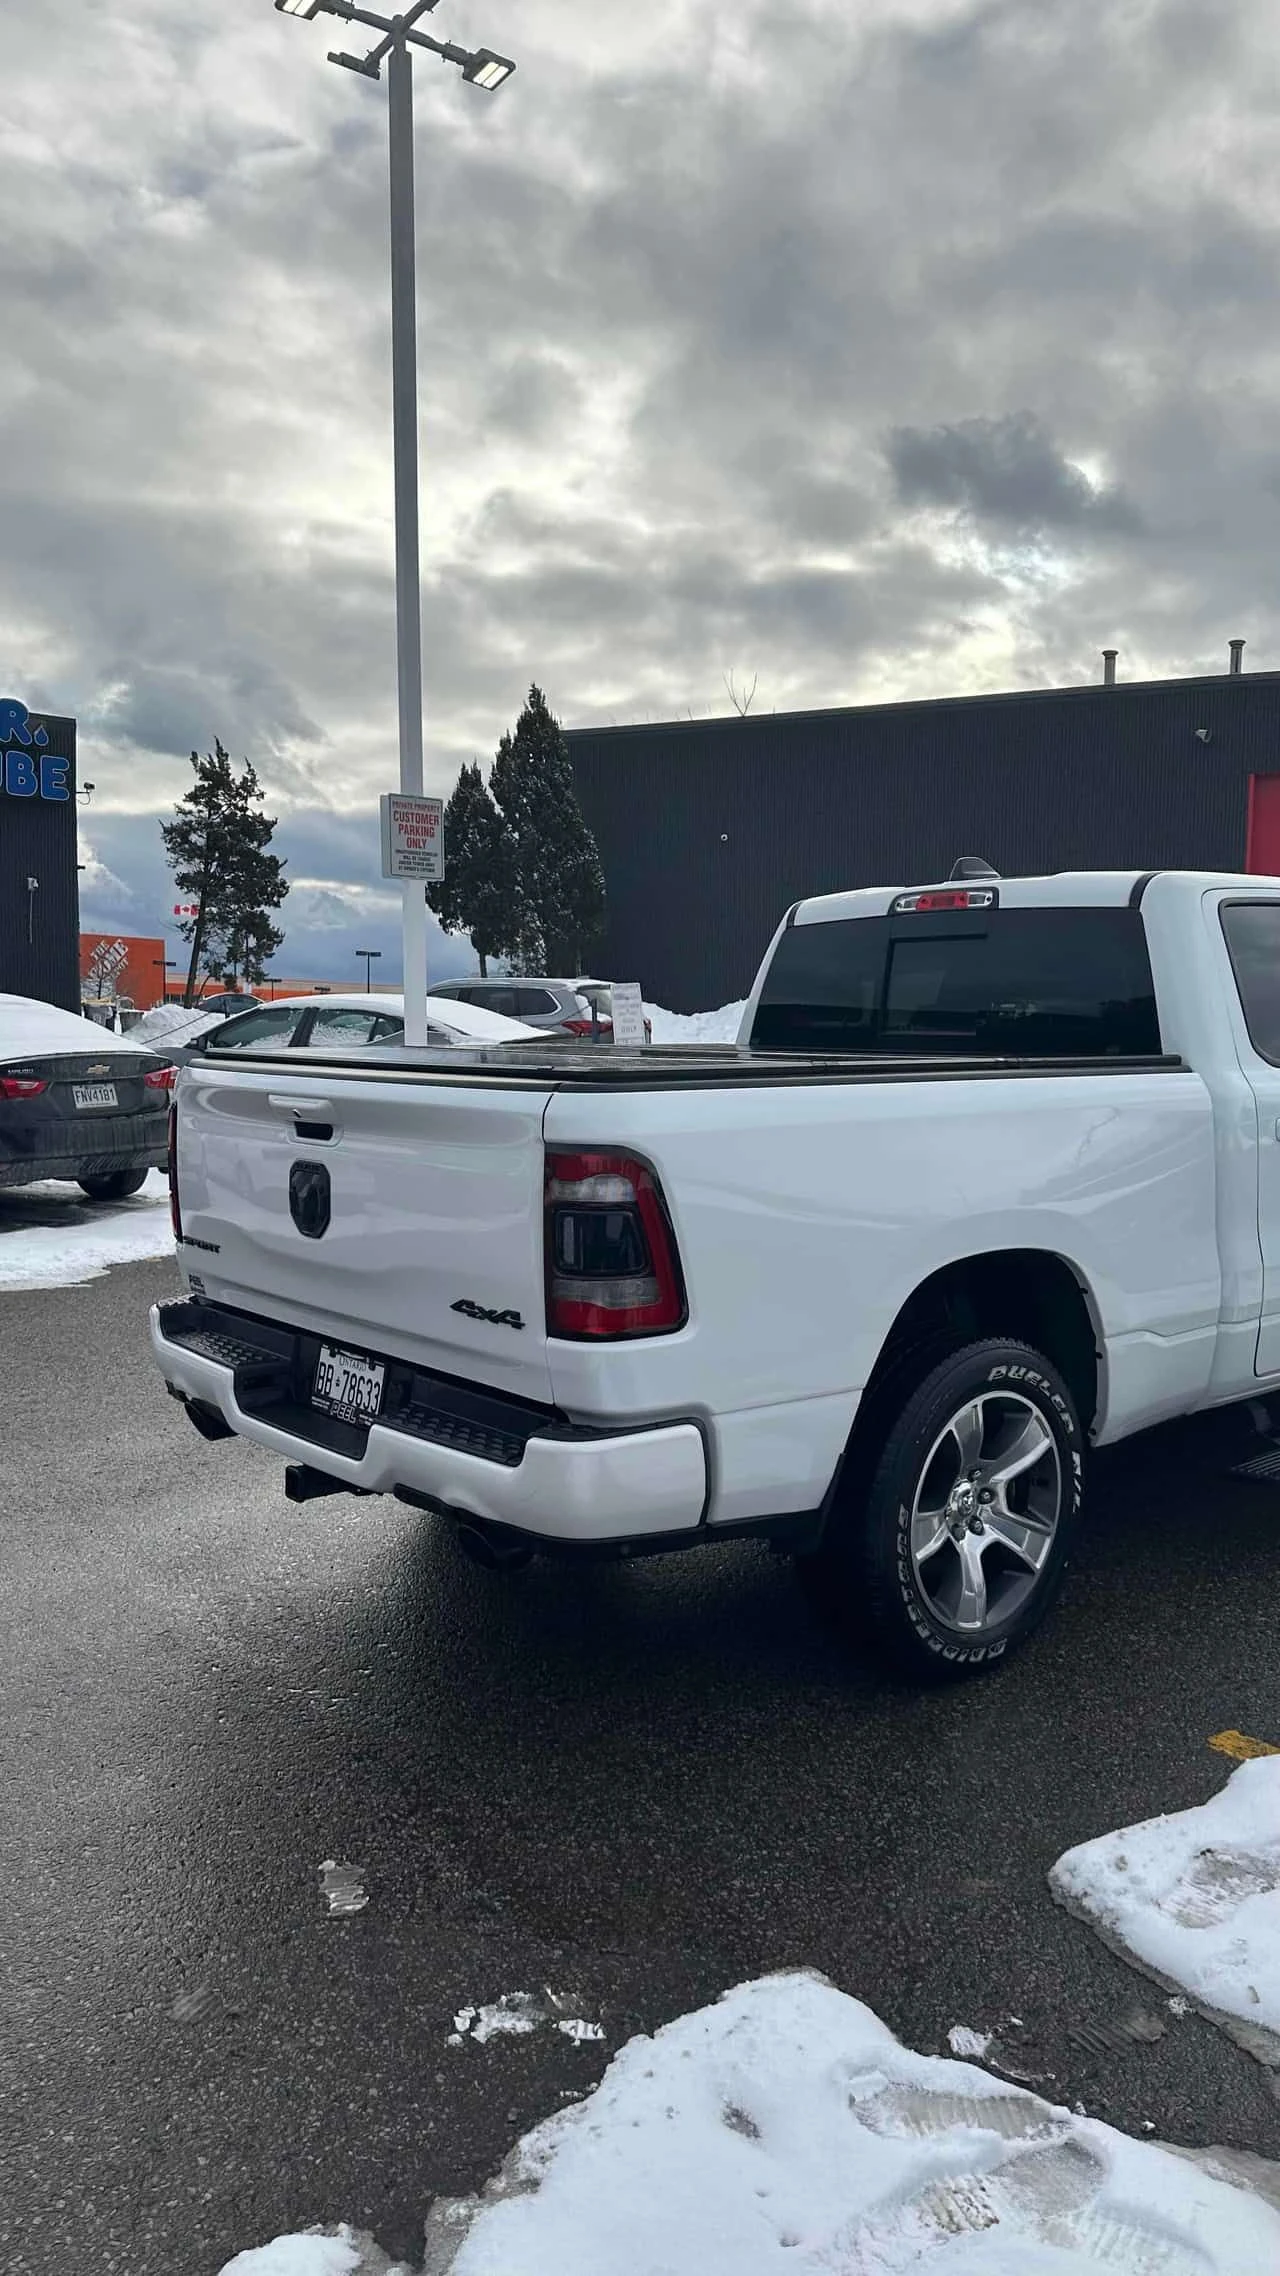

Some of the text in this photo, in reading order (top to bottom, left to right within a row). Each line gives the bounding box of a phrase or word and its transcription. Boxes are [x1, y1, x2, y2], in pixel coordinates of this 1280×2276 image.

[0, 751, 69, 800] BE
[393, 811, 440, 825] CUSTOMER
[399, 824, 435, 838] PARKING
[406, 837, 427, 849] ONLY
[340, 1369, 381, 1413] 78633
[988, 1365, 1074, 1433] DUELER
[330, 1400, 357, 1424] PEEL
